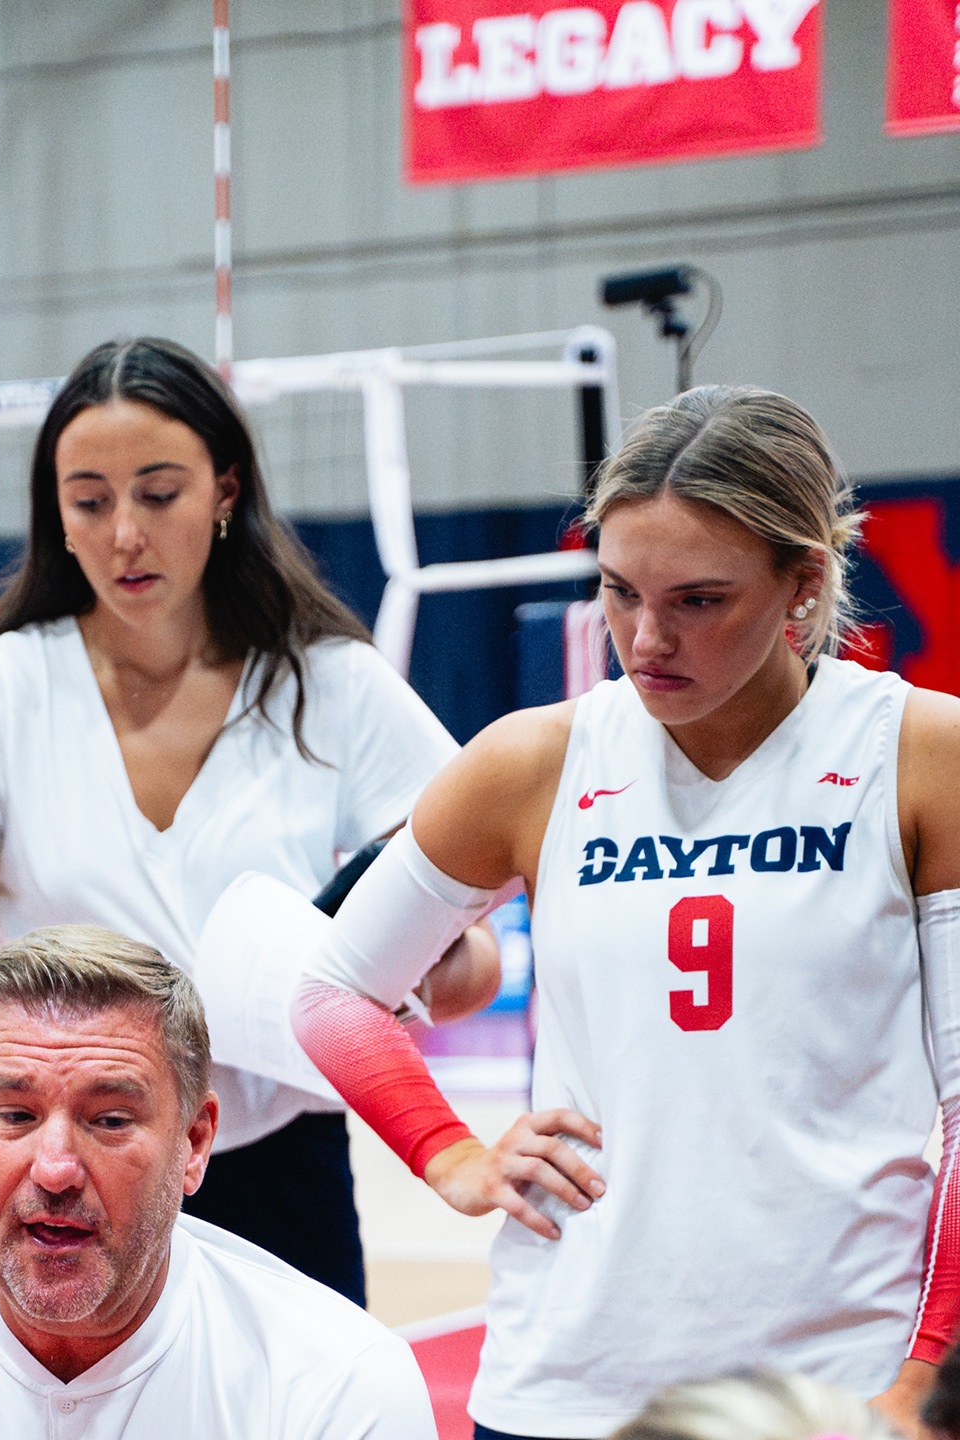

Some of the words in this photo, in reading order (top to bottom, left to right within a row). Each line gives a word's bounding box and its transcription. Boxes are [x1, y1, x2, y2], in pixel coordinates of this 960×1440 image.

[415, 0, 819, 109] LEGACY
[577, 821, 853, 887] DAYTON
[667, 893, 735, 1032] 9
